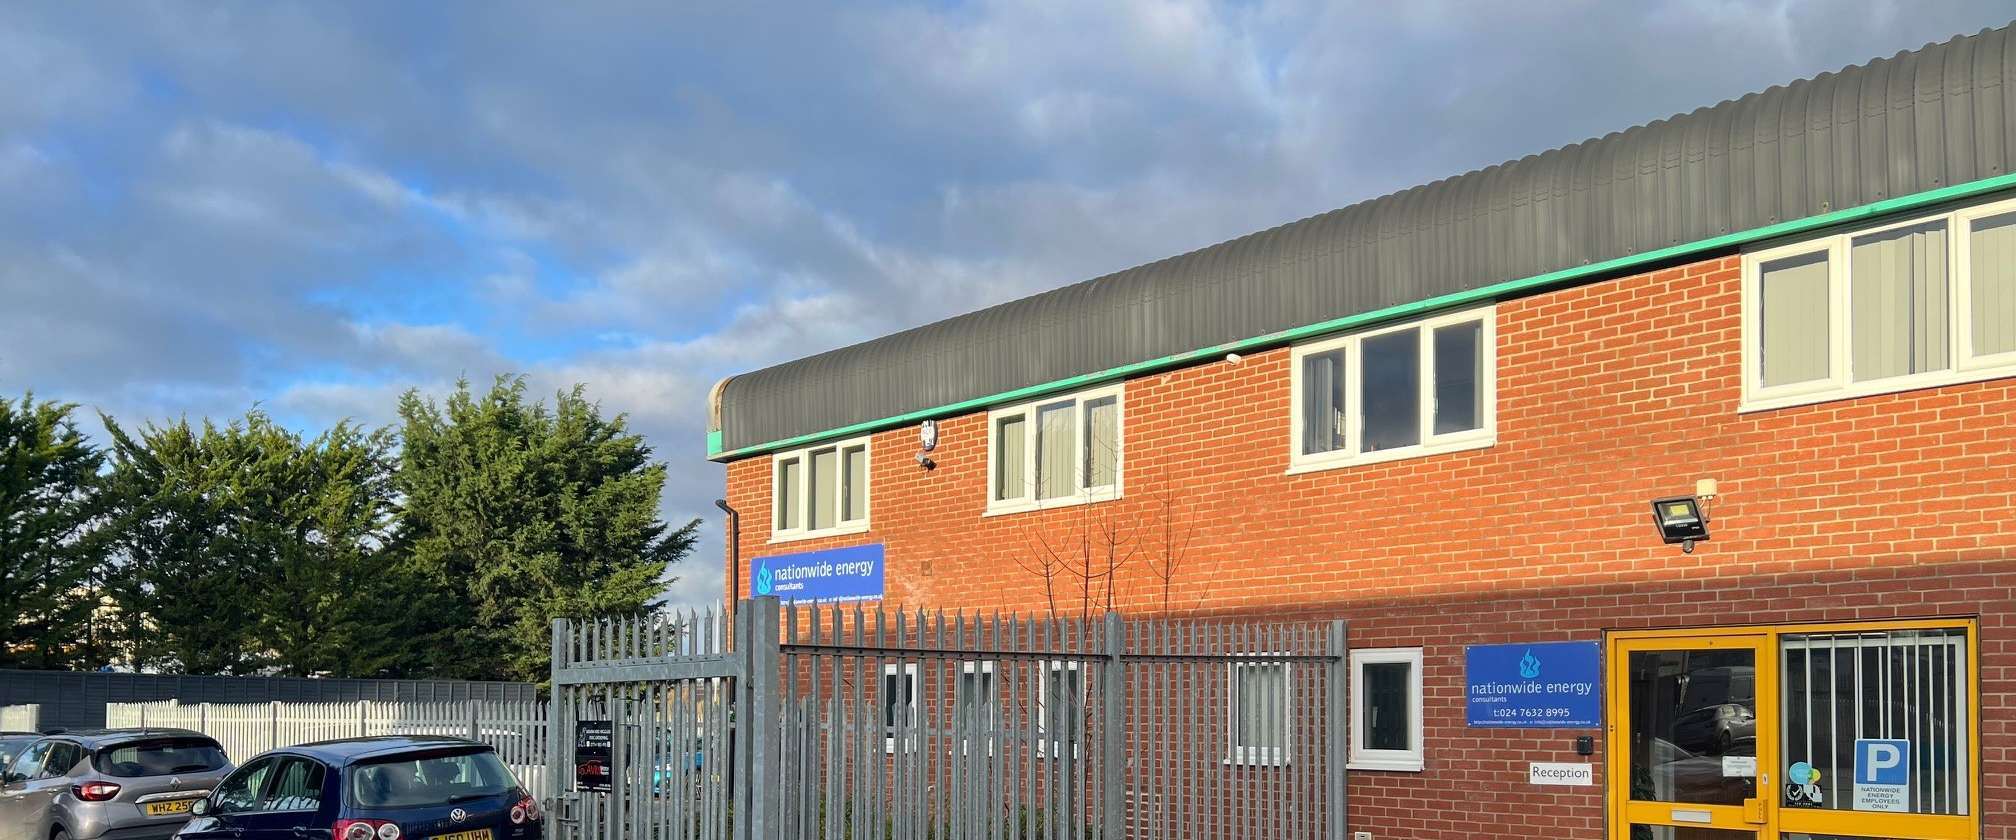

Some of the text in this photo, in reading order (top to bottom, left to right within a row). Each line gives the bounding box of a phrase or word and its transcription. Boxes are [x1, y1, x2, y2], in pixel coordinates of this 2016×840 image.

[775, 560, 874, 580] nationwide energy
[1472, 681, 1592, 695] nationwide energy
[1493, 708, 1570, 717] t:024 7632 8995
[1867, 744, 1900, 781] P
[1532, 766, 1589, 780] Reception
